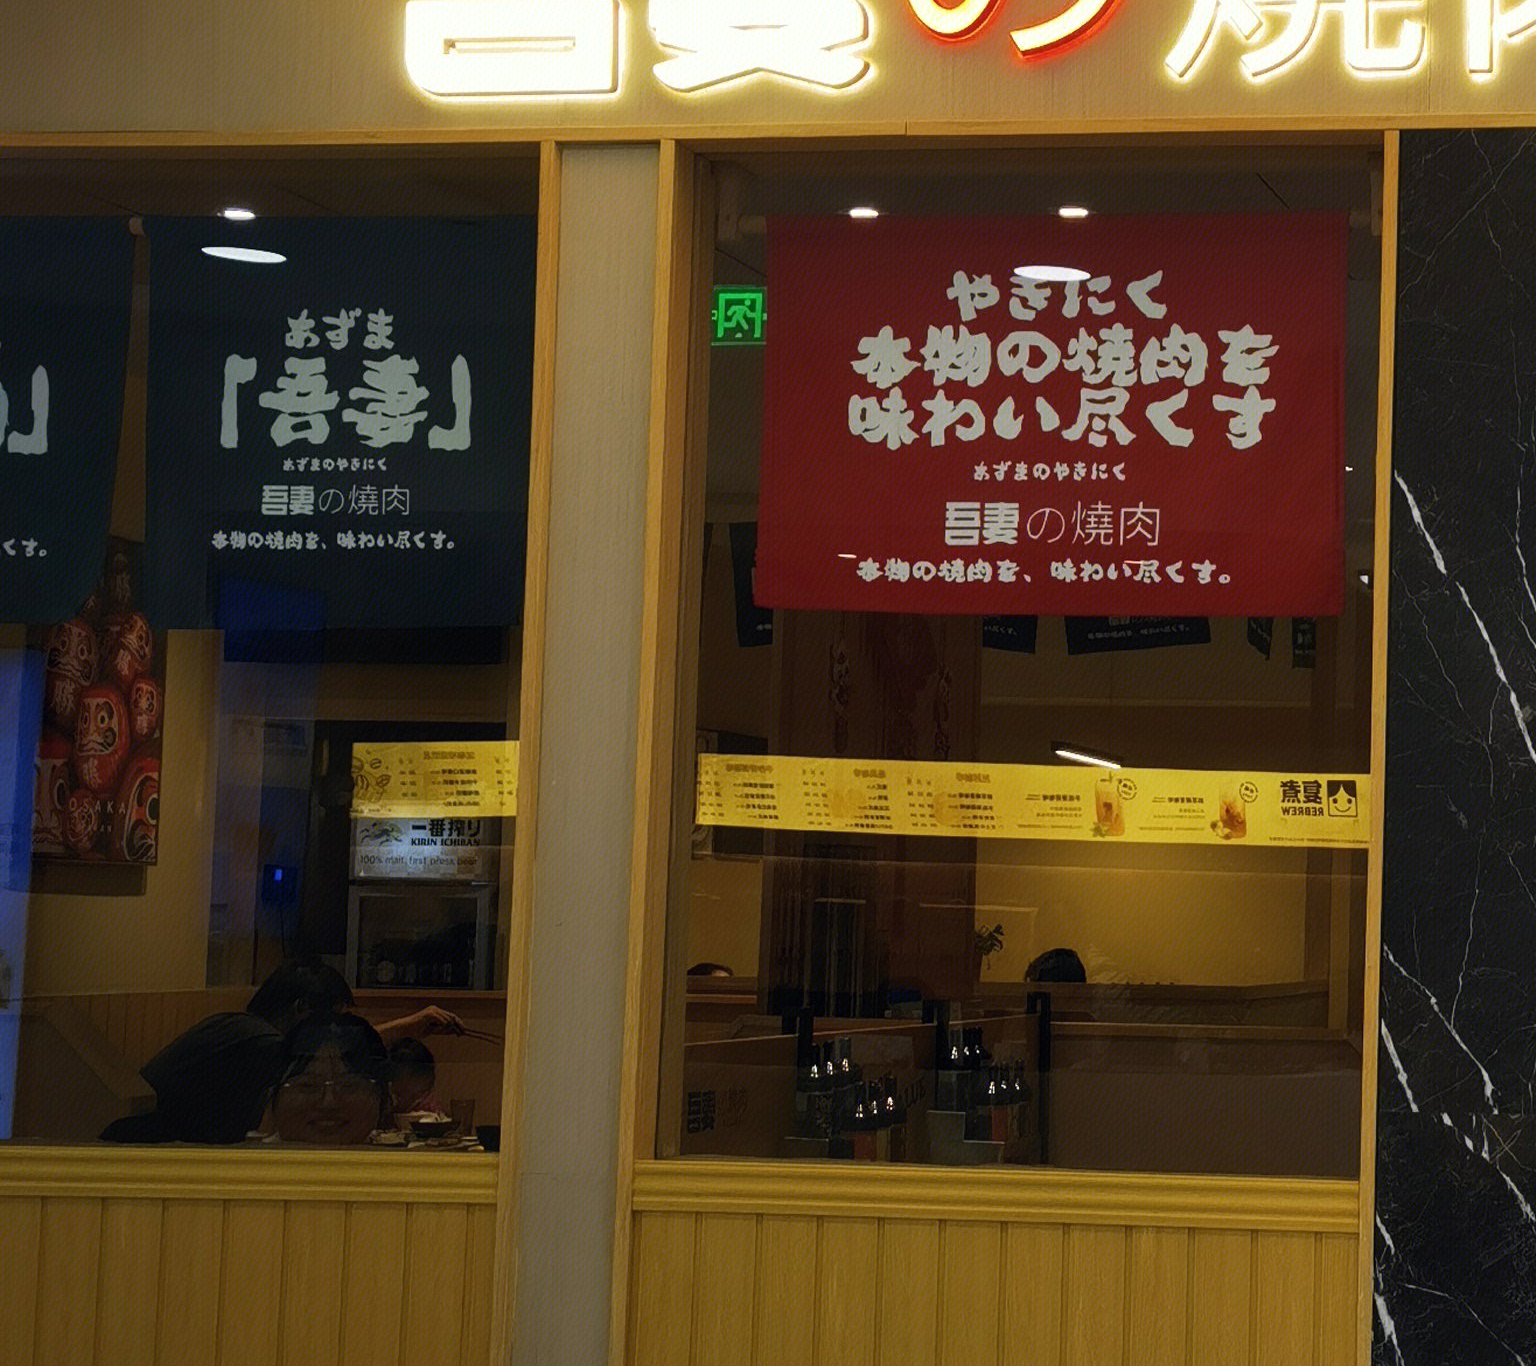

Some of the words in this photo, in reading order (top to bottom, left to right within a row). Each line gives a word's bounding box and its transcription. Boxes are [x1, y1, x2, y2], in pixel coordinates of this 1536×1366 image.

[946, 269, 1167, 322] やきにく
[285, 308, 395, 350] あずま
[220, 353, 472, 451] 「吾妻」
[848, 386, 1277, 450] 味わい尽くす
[282, 457, 388, 472] あずまのやきにく
[973, 461, 1127, 482] あずまのやきにく
[411, 837, 438, 847] KIRIN
[440, 837, 481, 847] ICHIBAN
